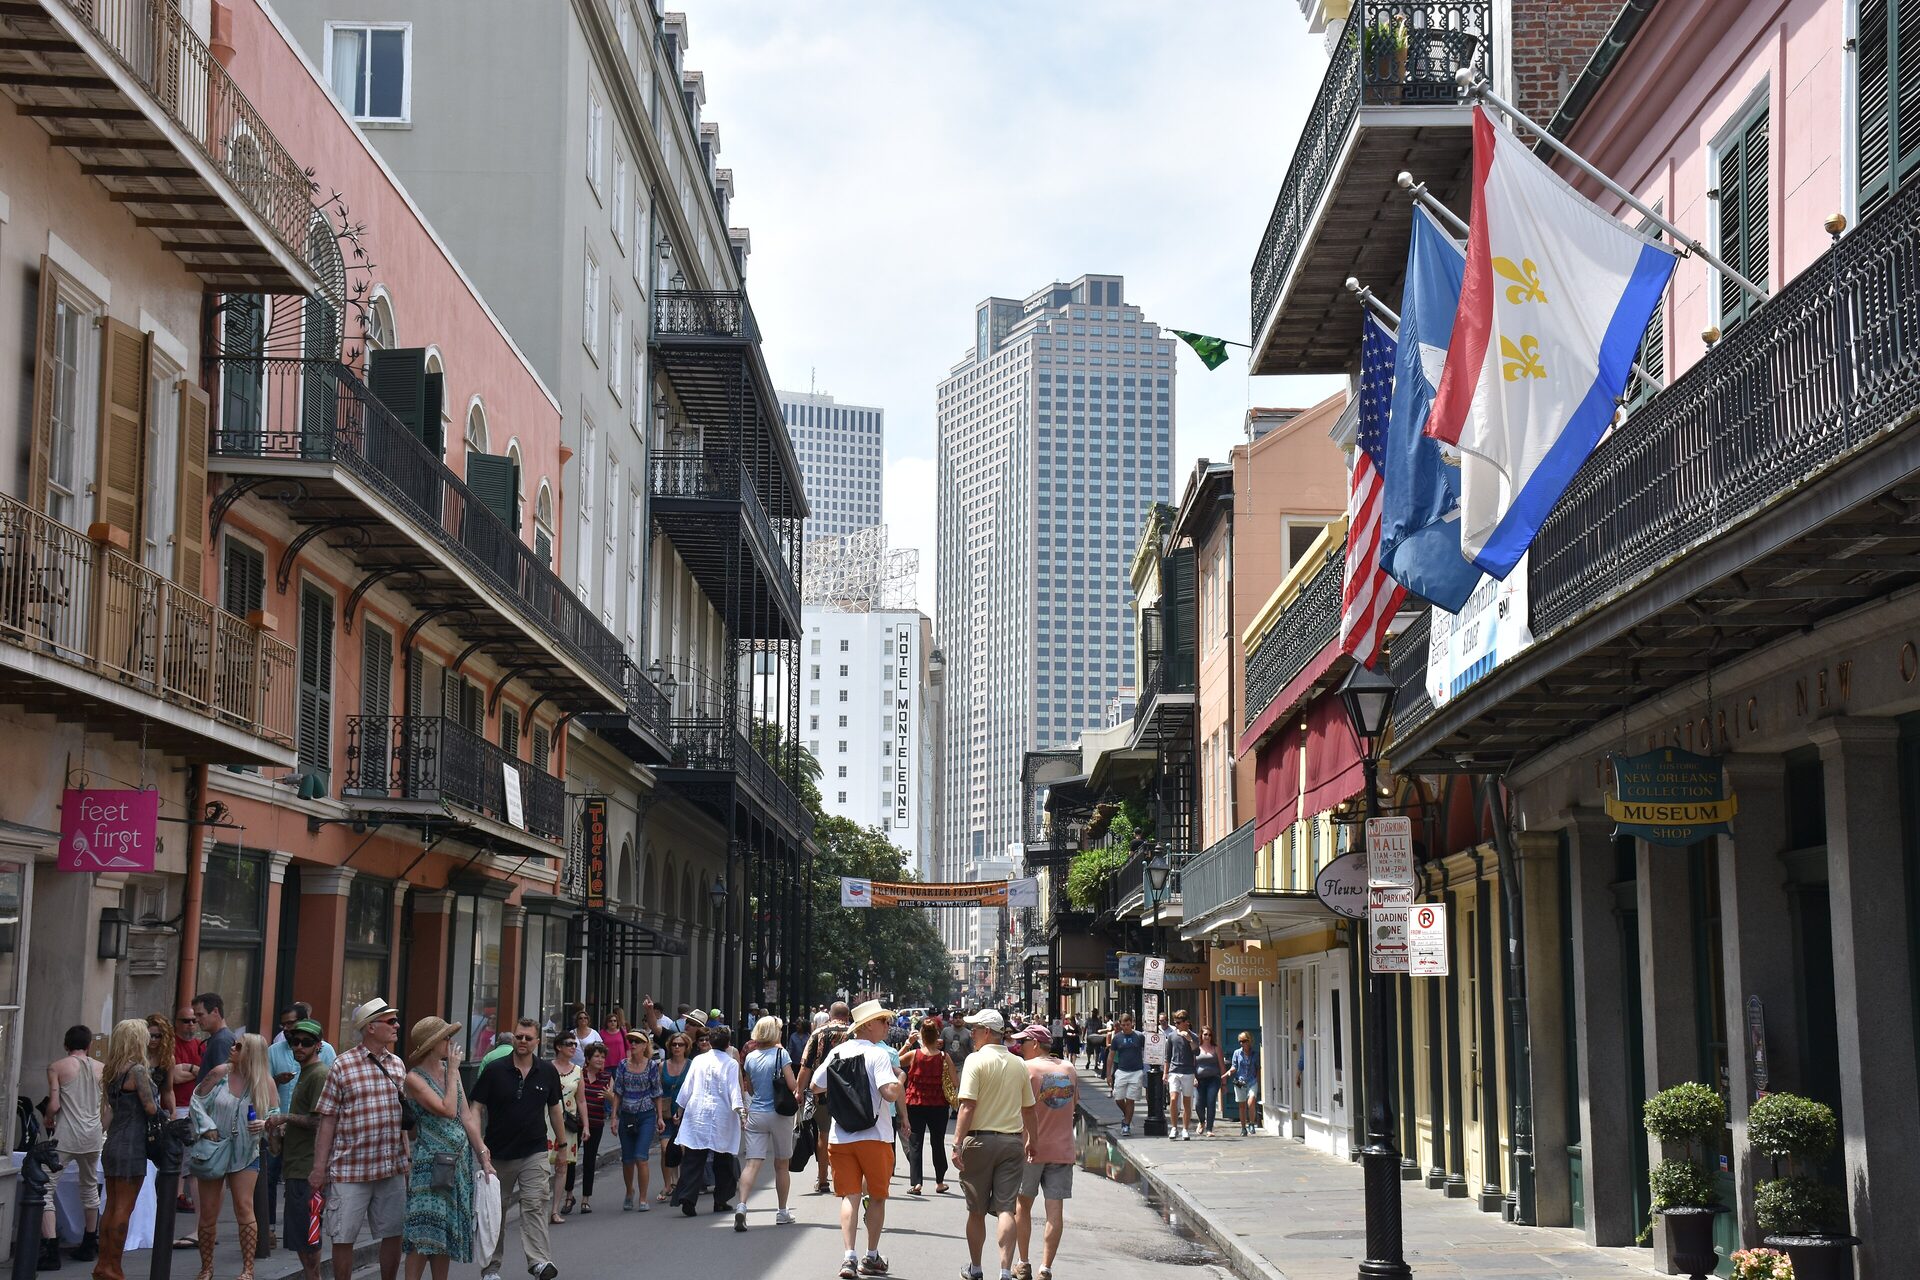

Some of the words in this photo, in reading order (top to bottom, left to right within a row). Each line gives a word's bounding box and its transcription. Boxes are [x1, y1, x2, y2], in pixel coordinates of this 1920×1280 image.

[1498, 597, 1510, 619] BMI
[1463, 620, 1480, 656] STAGE
[899, 631, 909, 690] HOTEL
[1795, 660, 1853, 717] NEW
[897, 699, 909, 819] MONTELEONE
[1624, 773, 1652, 783] NEW
[1656, 773, 1717, 783] ORLEANS
[1628, 786, 1713, 797] COLLECTION
[79, 797, 129, 821] feet
[1623, 805, 1720, 821] MUSEUM
[1381, 822, 1408, 833] PARKING
[1652, 828, 1692, 839] SHOP
[93, 823, 142, 854] first
[1373, 838, 1406, 851] MALL
[872, 887, 907, 896] FRENCH
[910, 887, 950, 897] QUARTER
[953, 887, 994, 896] FESTIVAL
[1322, 879, 1363, 897] Fleur
[1371, 891, 1383, 906] NO
[1383, 893, 1410, 903] PARKING
[1375, 912, 1408, 922] LOADING
[1223, 952, 1265, 965] Sutton
[1216, 964, 1272, 976] Galleries
